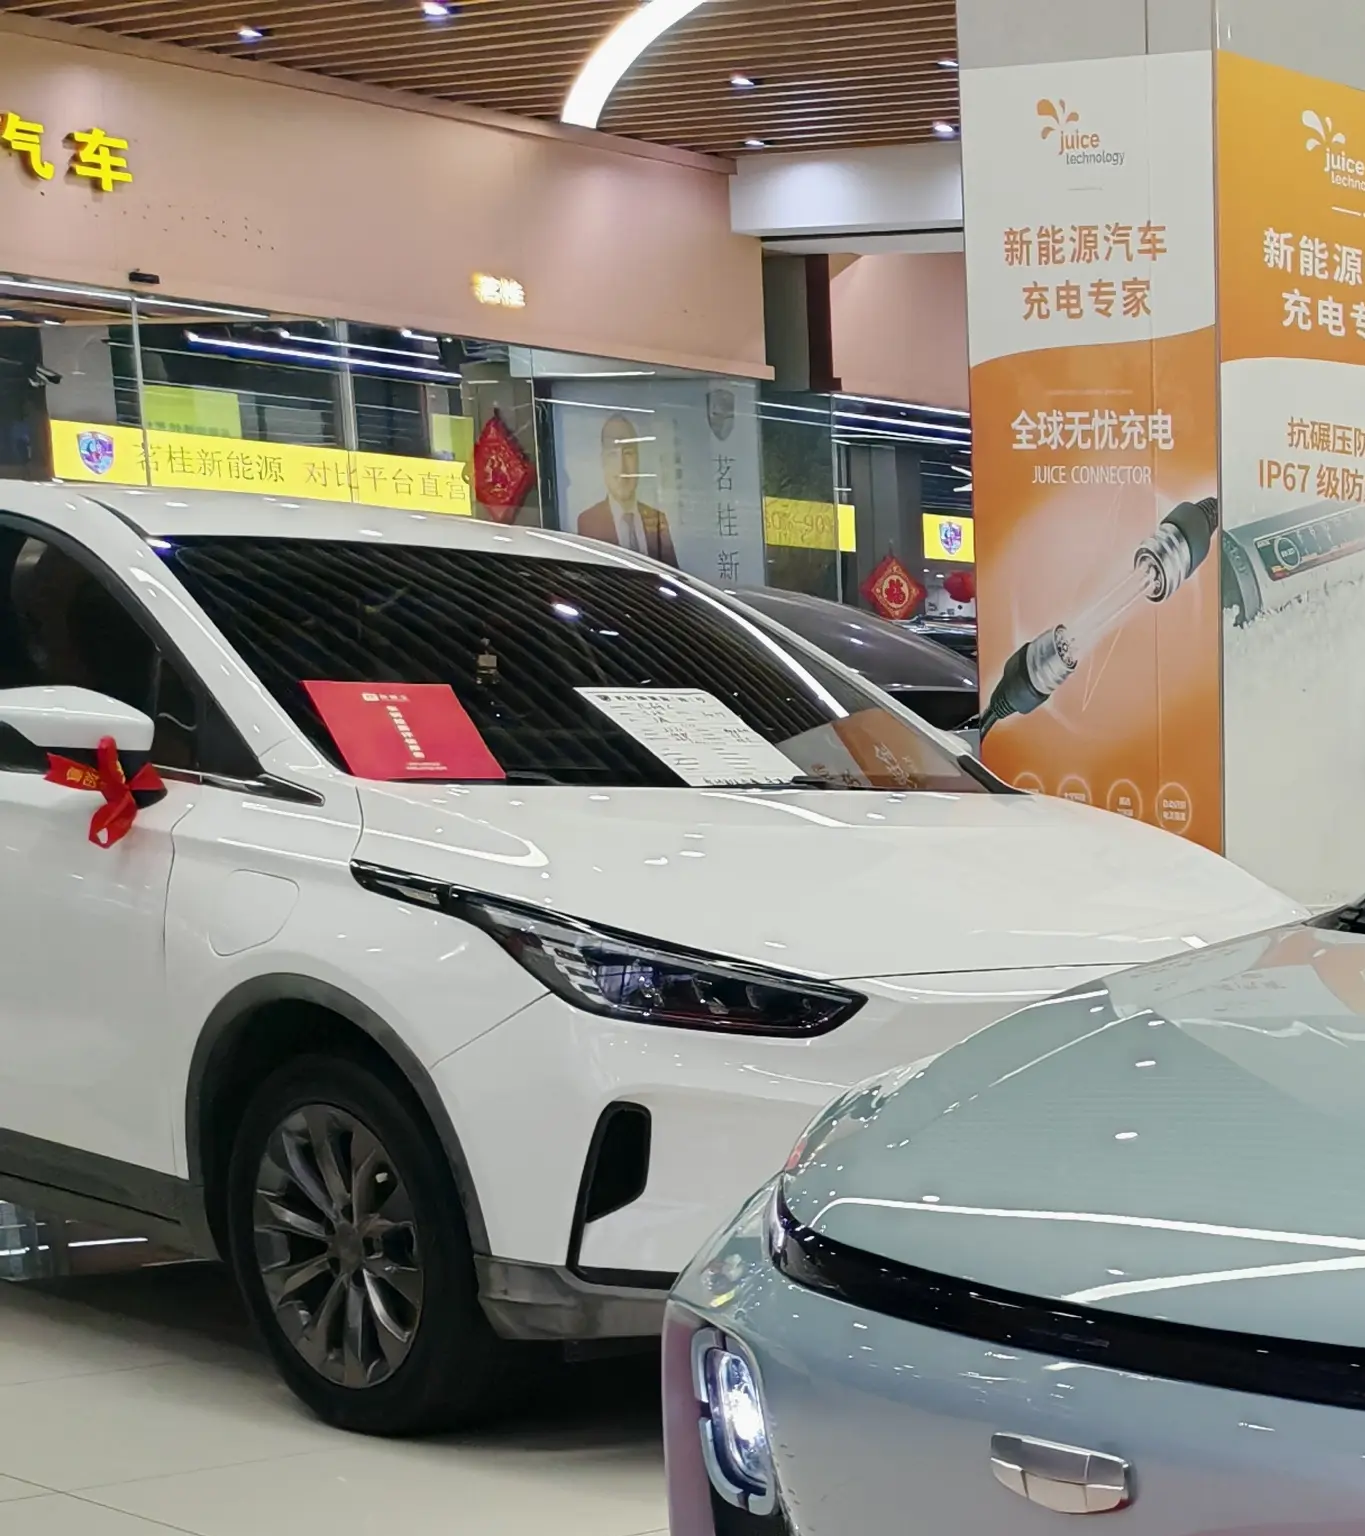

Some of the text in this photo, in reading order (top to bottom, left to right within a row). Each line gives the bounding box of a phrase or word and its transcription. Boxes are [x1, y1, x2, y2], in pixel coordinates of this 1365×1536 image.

[1058, 129, 1101, 156] juice
[1066, 149, 1125, 166] technology
[1324, 147, 1365, 176] juice
[1003, 220, 1167, 266] 新能源汽车
[1021, 277, 1152, 321] 充电专家
[1010, 408, 1174, 451] 全球无忧充电
[132, 443, 285, 482] 茗桂新能源
[1032, 465, 1152, 485] JUICE CONNECTOR
[1258, 459, 1311, 493] IP67
